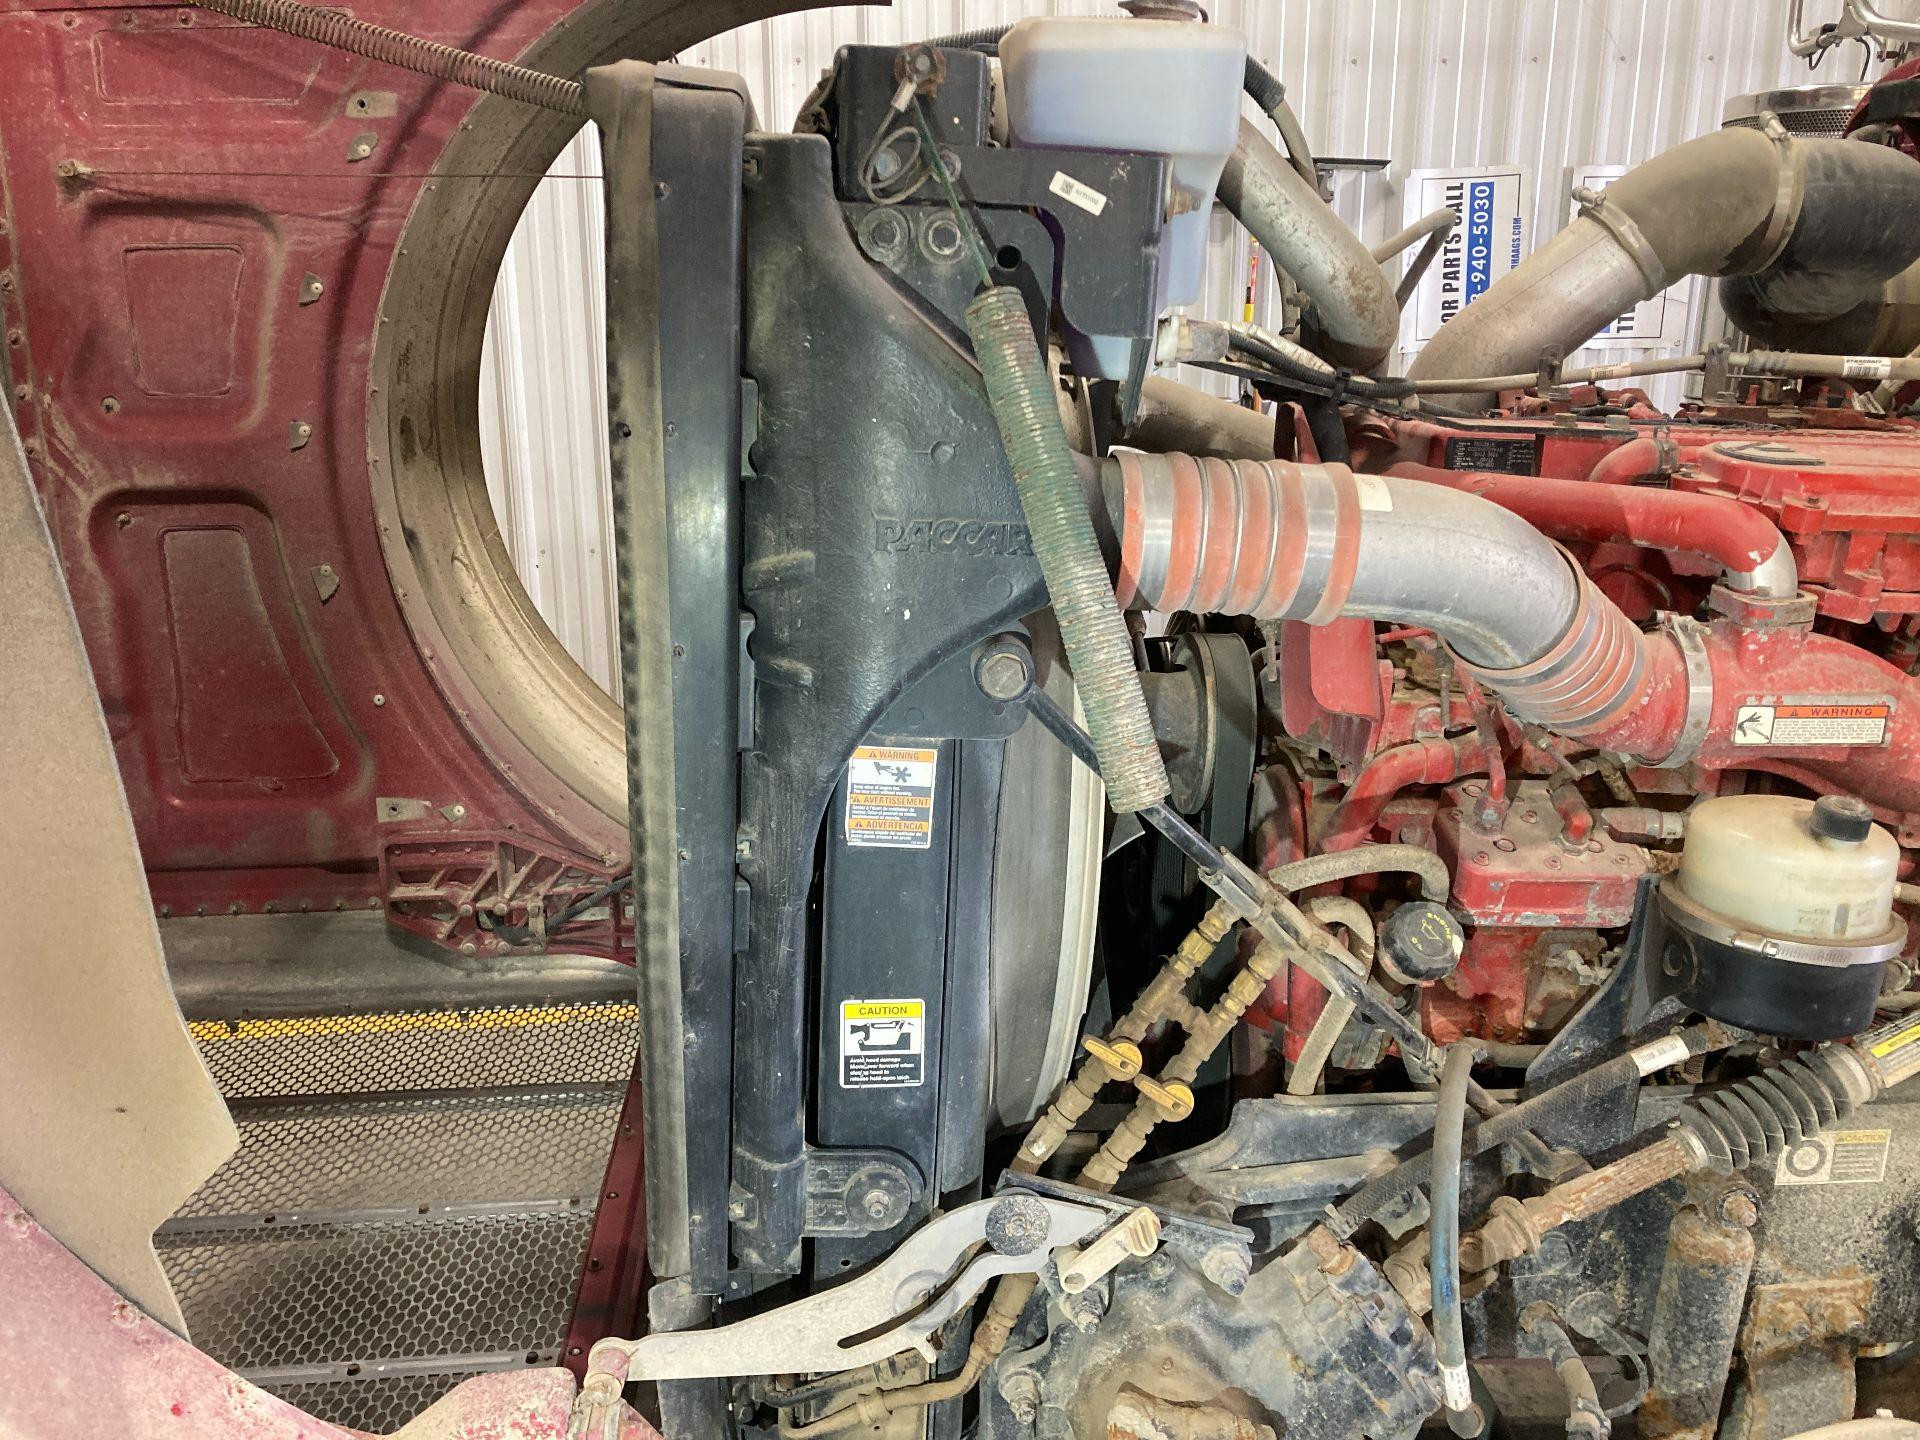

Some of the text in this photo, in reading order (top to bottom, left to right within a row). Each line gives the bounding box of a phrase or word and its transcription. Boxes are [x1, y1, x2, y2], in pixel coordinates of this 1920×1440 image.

[1442, 233, 1462, 293] PARTS
[1440, 299, 1459, 325] OR
[875, 518, 1034, 556] PACCAR
[1811, 708, 1873, 716] WARNING
[879, 750, 919, 760] WARNING
[863, 796, 929, 807] AVERTISSEMENT
[866, 820, 923, 831] ADVERTENCIA
[1427, 912, 1451, 940] ENGINE
[1411, 937, 1423, 951] OIL
[859, 1006, 908, 1016] CAUTION
[1845, 1132, 1885, 1142] CAUTION
